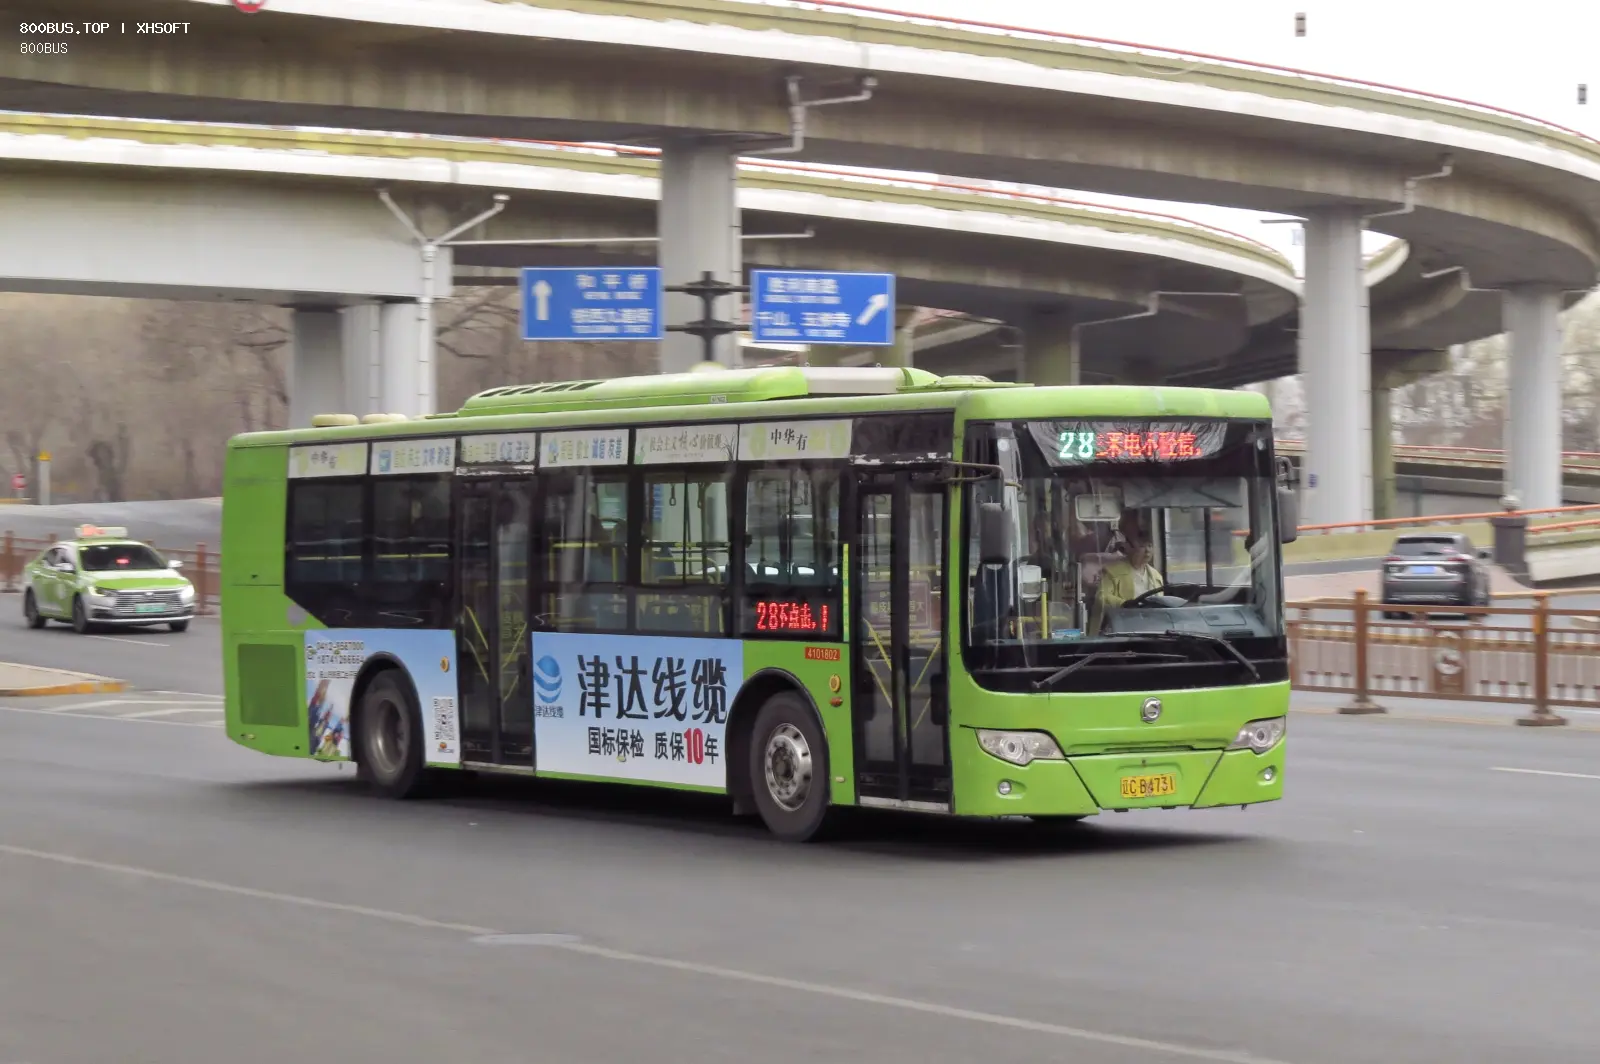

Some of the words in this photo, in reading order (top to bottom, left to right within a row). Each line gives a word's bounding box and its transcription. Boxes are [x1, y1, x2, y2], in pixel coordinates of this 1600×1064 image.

[807, 648, 838, 660] 4101802
[577, 654, 727, 724] 津达线缆
[534, 705, 564, 719] 津达线缆
[588, 726, 645, 759] 国标保检
[654, 727, 719, 765] 质保10年
